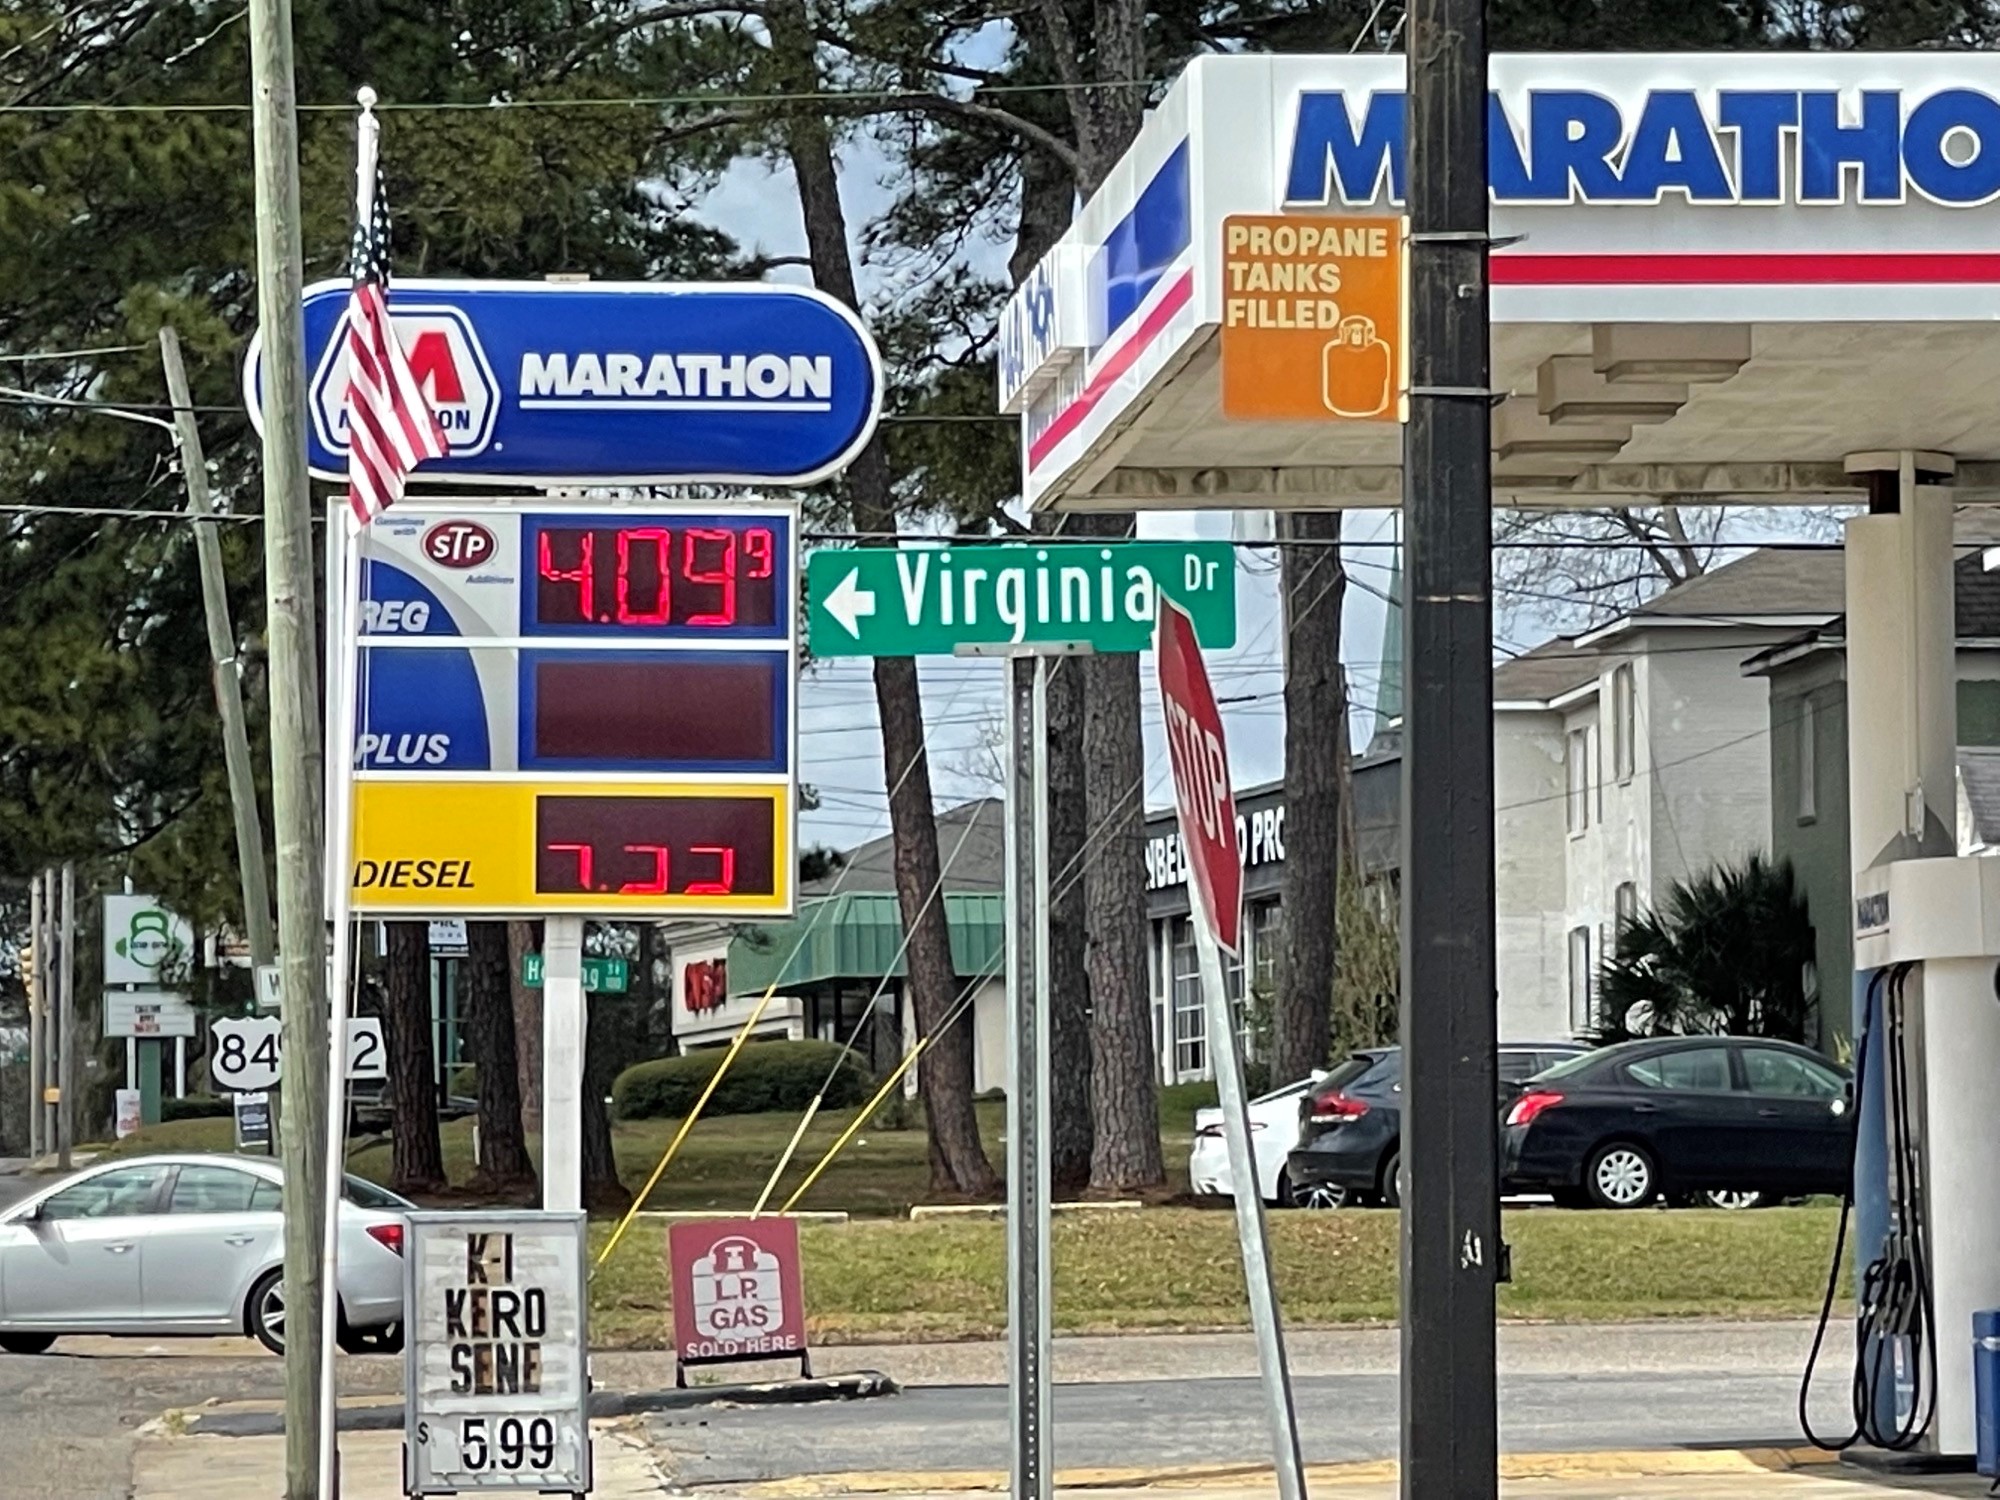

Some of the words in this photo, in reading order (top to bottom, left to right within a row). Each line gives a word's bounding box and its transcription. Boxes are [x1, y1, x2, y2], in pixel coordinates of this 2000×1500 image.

[1228, 225, 1388, 257] PROPANE
[1228, 262, 1341, 293] TANKS
[1227, 299, 1340, 329] FILLED
[520, 353, 831, 398] MARATHON
[433, 526, 486, 561] STP
[896, 551, 1154, 643] Virginia
[1184, 553, 1219, 591] Dr
[359, 600, 430, 633] REG
[354, 733, 450, 764] PLUS
[1166, 692, 1227, 849] STOP
[353, 860, 475, 888] DIESEL
[220, 1033, 279, 1074] 84
[445, 1287, 546, 1339] KERO
[710, 1305, 769, 1330] GAS
[686, 1340, 738, 1358] SOLD
[746, 1334, 797, 1353] HERE
[451, 1342, 541, 1395] SENE
[417, 1421, 429, 1445] $
[462, 1417, 554, 1470] 5.99
